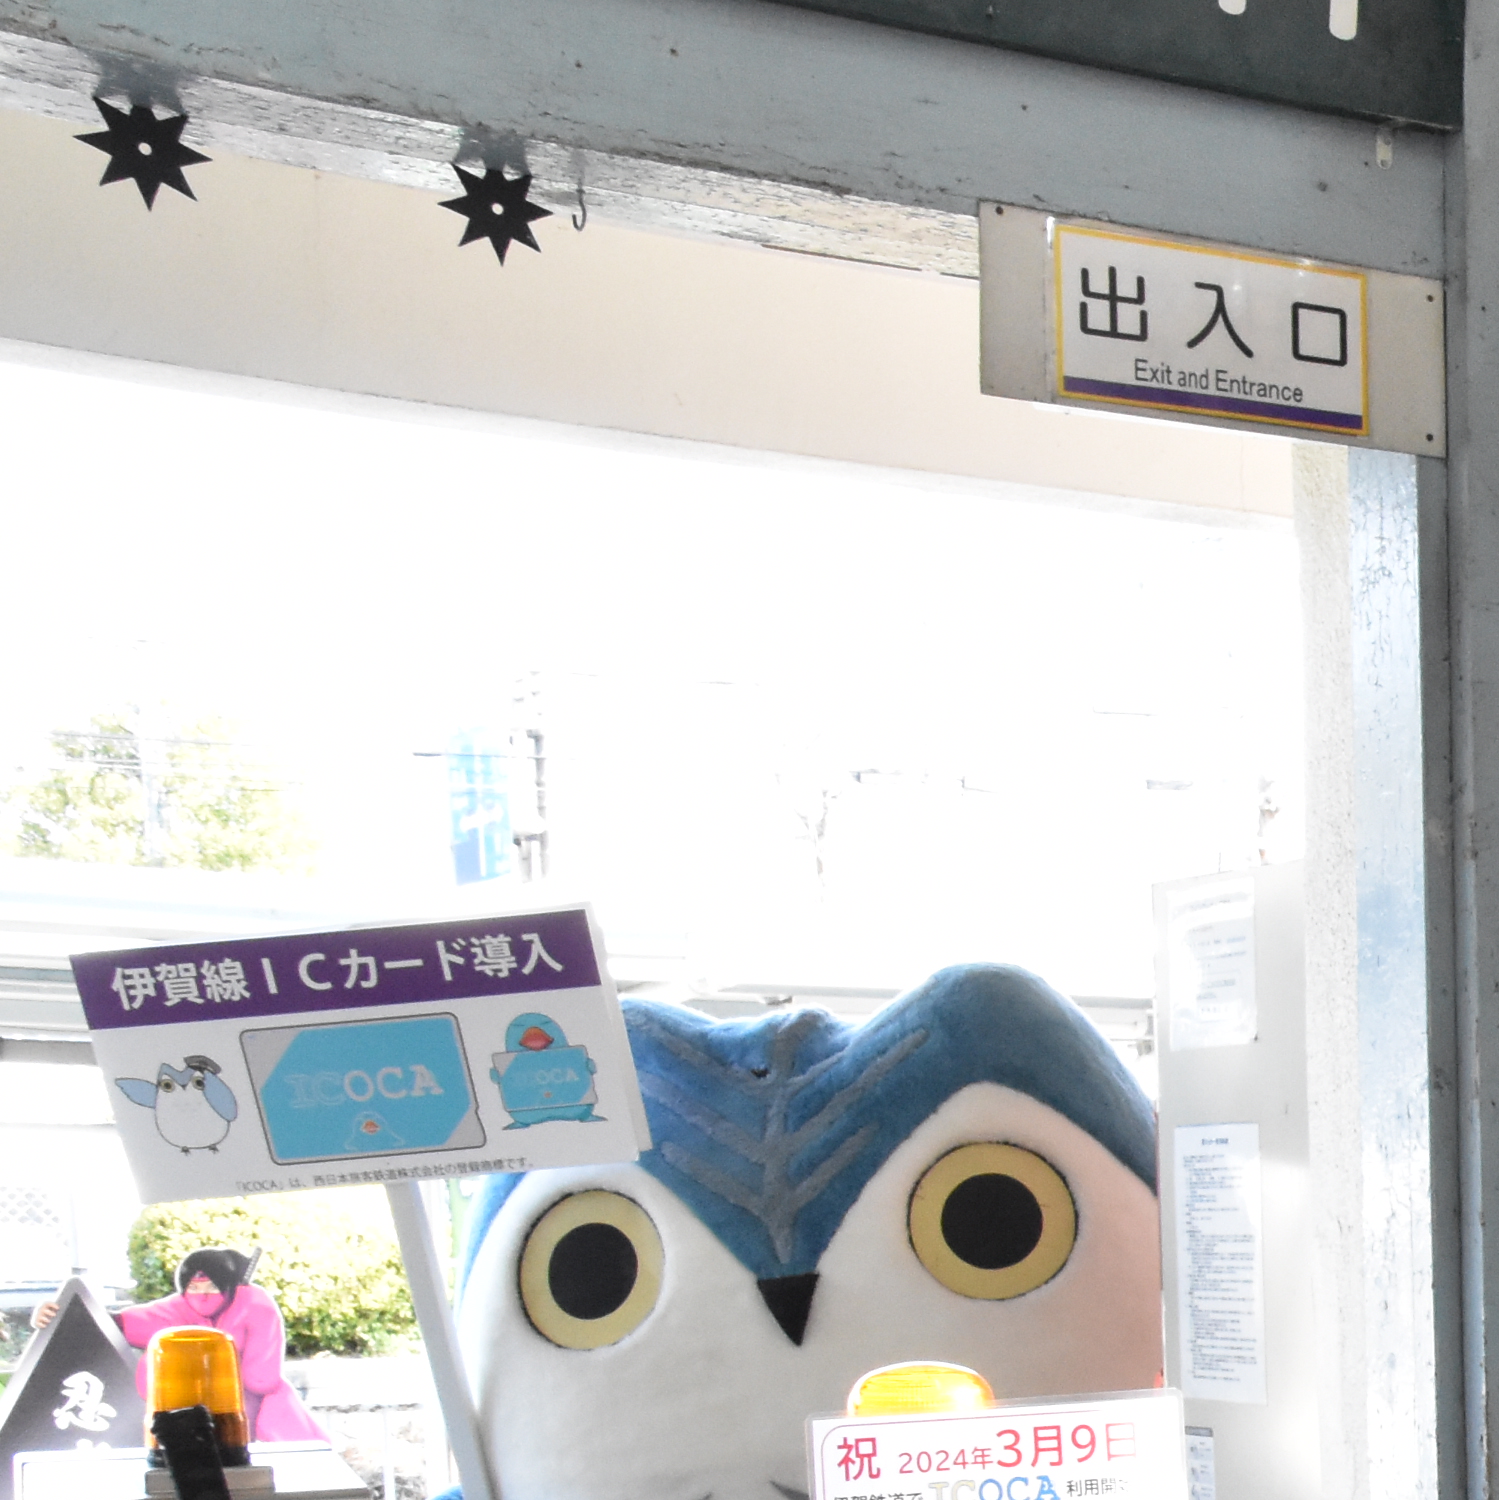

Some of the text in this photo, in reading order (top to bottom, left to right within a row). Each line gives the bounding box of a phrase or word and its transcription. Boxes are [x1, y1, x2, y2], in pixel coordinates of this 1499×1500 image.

[1079, 266, 1348, 368] 出入口
[1134, 359, 1304, 403] Exit and Entrance
[112, 932, 563, 1012] 伊賀線ICカード導入
[285, 1064, 444, 1108] ICOCA
[53, 1371, 117, 1431] 忍
[836, 1437, 881, 1481] 祝
